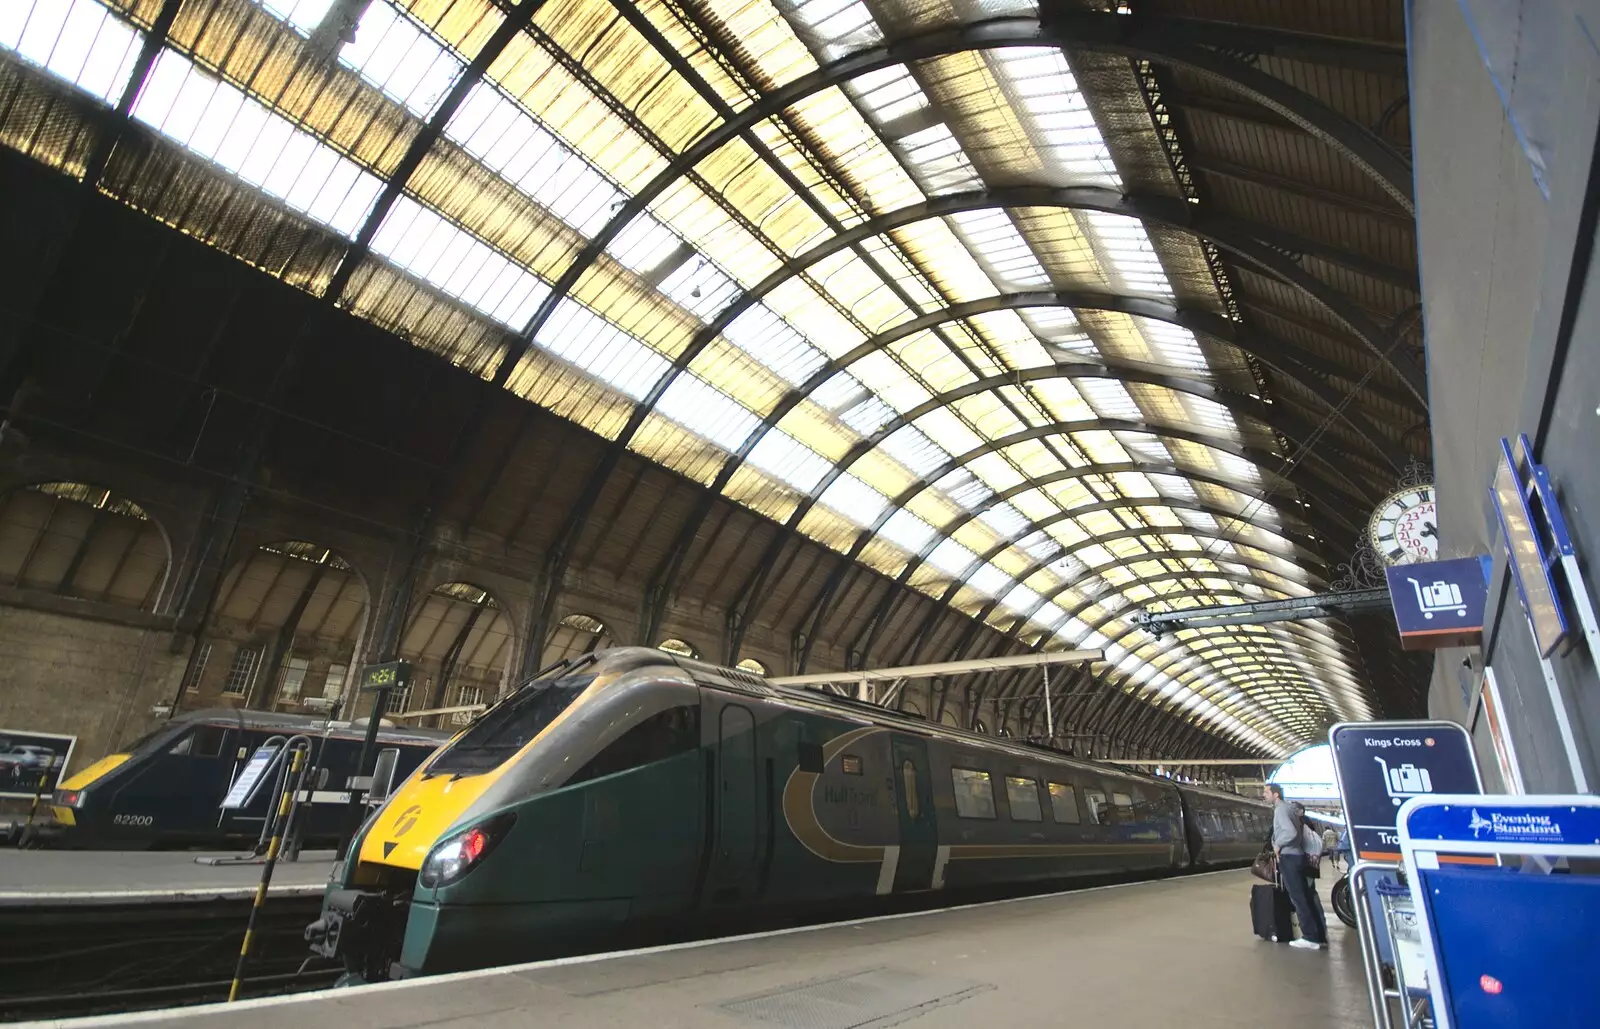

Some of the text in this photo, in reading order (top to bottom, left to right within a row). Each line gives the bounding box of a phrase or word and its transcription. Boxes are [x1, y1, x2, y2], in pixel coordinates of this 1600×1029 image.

[1419, 505, 1434, 514] 24
[1405, 512, 1420, 521] 23
[1398, 522, 1415, 531] 22
[1398, 530, 1410, 540] 21
[1404, 539, 1421, 548] 20
[1416, 547, 1429, 556] 19
[1364, 737, 1422, 748] Kings Cross
[113, 814, 153, 826] 82200
[1490, 813, 1551, 826] Evening
[1493, 823, 1561, 834] Standard
